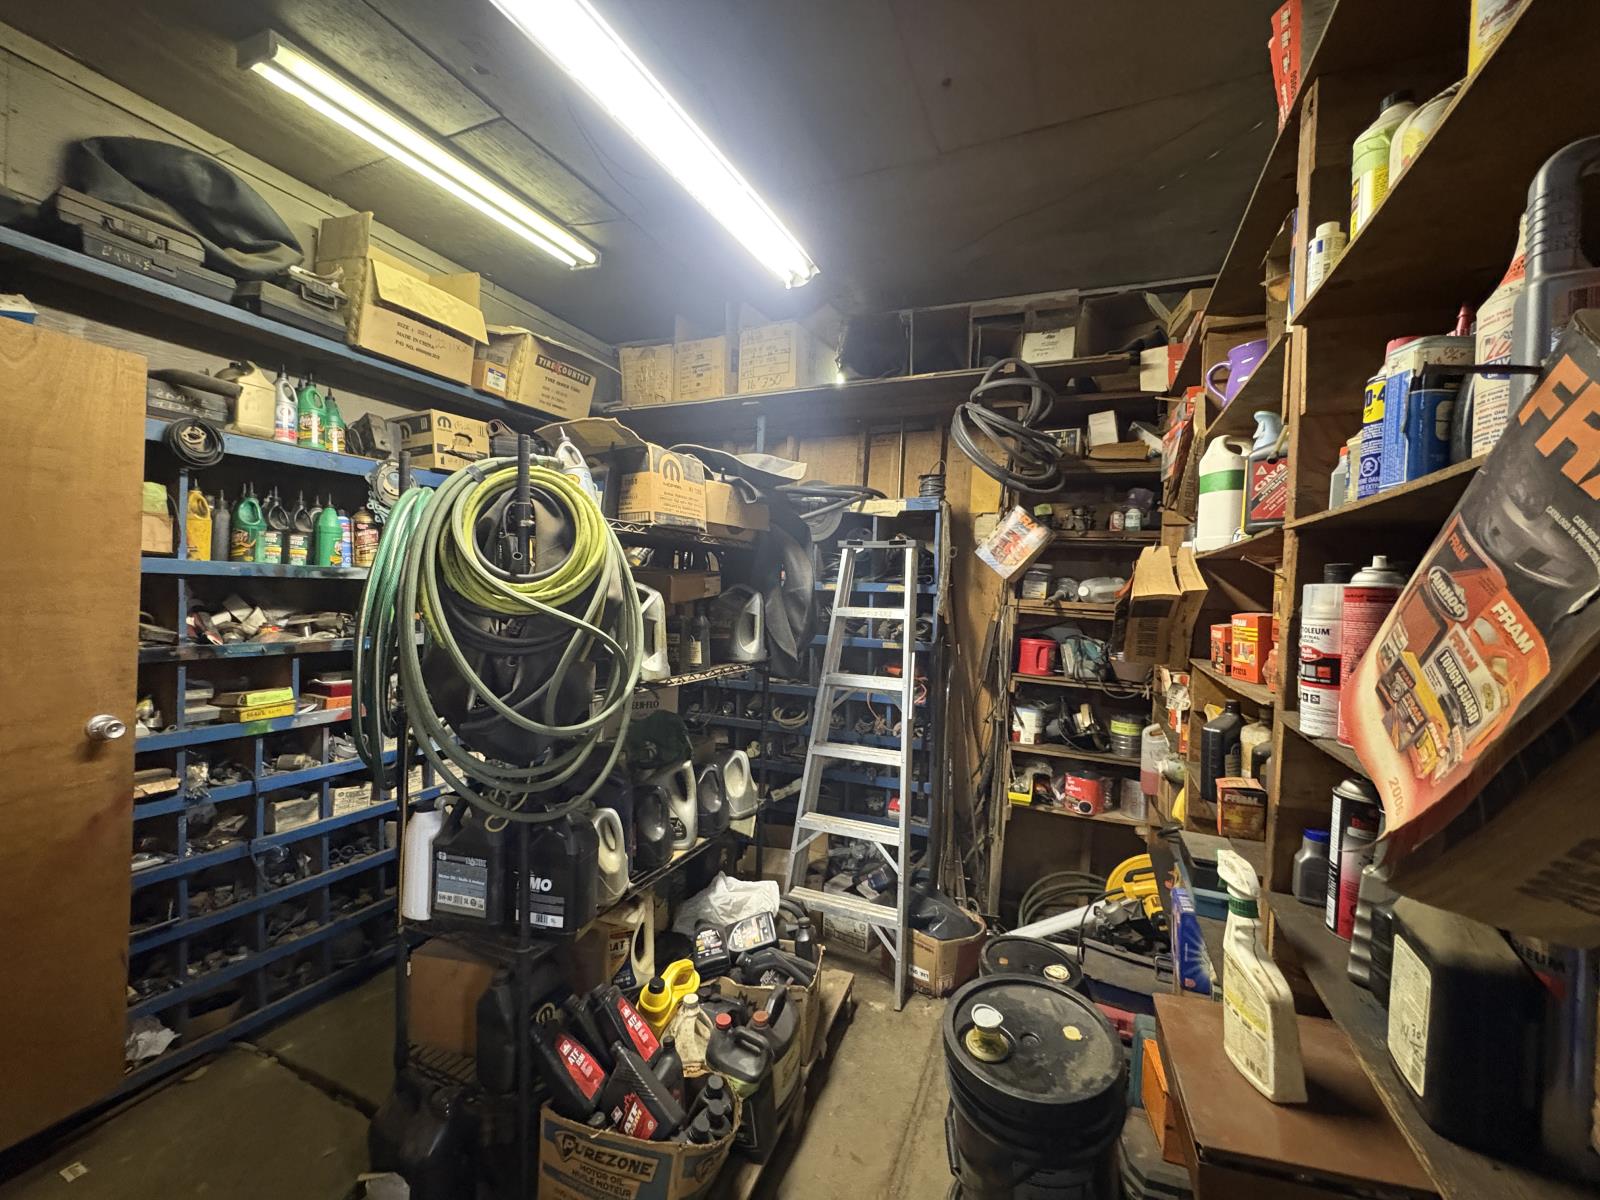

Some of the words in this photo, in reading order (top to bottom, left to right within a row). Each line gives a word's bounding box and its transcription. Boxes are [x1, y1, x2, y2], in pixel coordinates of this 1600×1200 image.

[539, 356, 555, 370] TIRE
[559, 364, 590, 384] COUNTRY
[1518, 353, 1600, 500] FR
[1449, 532, 1469, 563] FRAM
[1430, 571, 1466, 618] AIRHOG
[1232, 618, 1248, 627] FRAM
[1490, 600, 1535, 655] FRAM
[1450, 632, 1480, 673] FRAM
[1439, 651, 1462, 690] TOUGH
[1454, 682, 1480, 726] GUARD
[1405, 692, 1425, 722] FRAM
[623, 1101, 638, 1134] ATF
[561, 1134, 654, 1177] PUREZONE
[580, 1164, 610, 1180] MOTOR
[609, 1174, 625, 1187] OIL
[595, 1179, 632, 1197] MOTEUR
